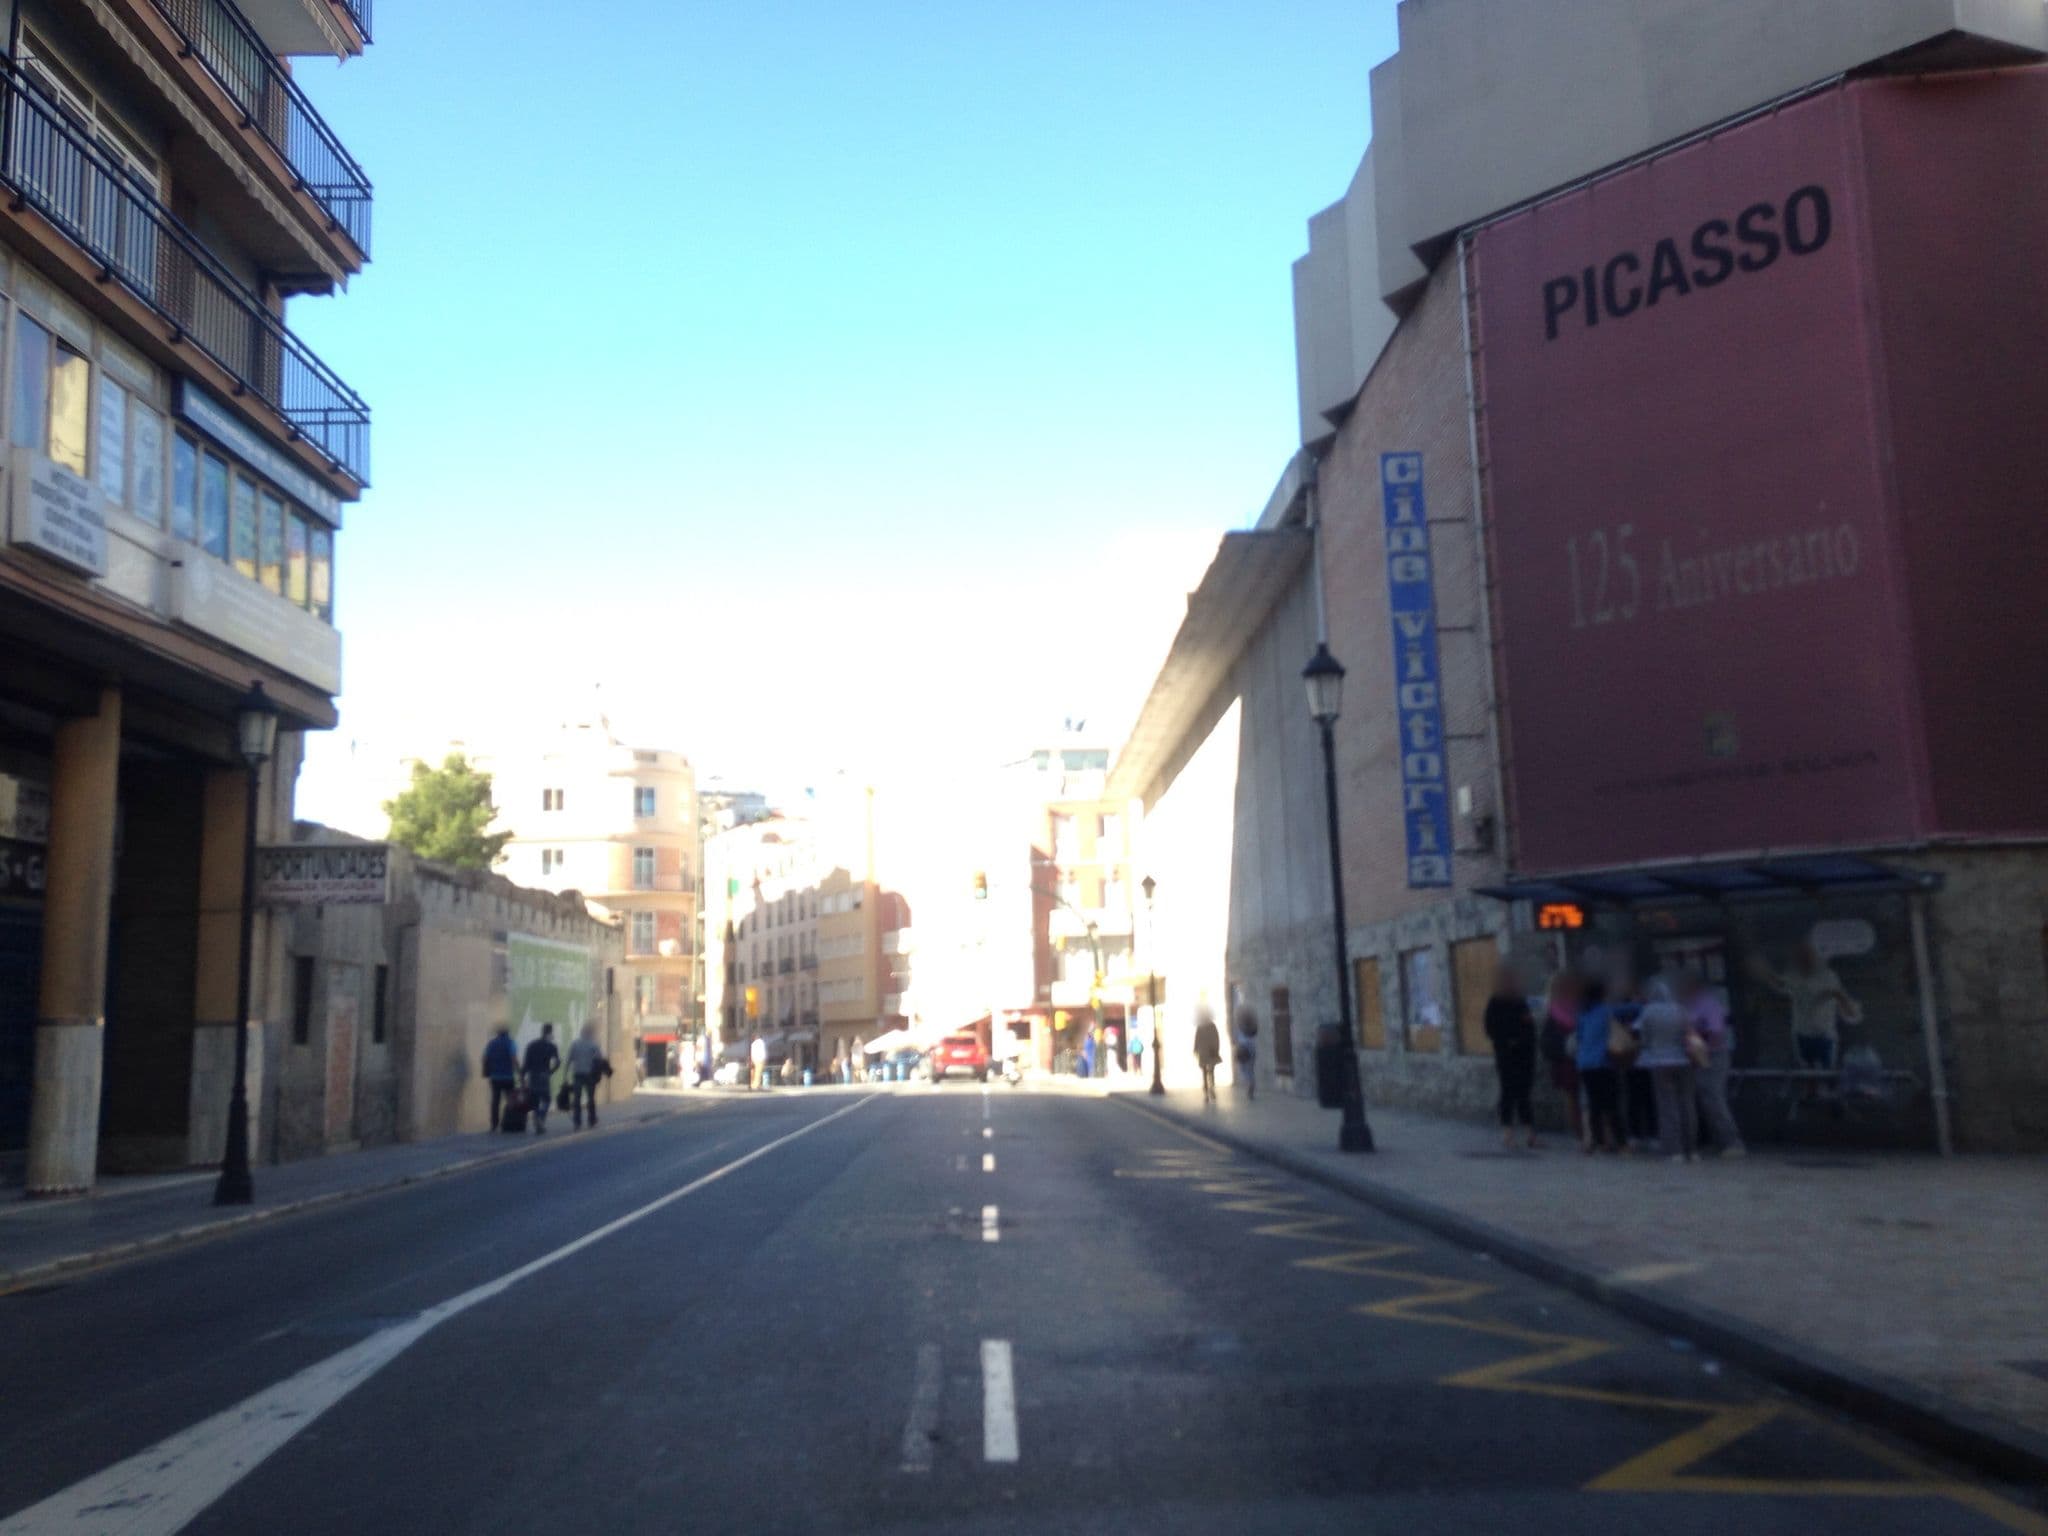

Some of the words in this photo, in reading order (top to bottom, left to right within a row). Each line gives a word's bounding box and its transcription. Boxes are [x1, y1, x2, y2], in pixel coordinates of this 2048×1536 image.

[1542, 185, 1832, 341] PICASSO
[1567, 523, 1641, 629] 125
[1655, 503, 1859, 611] Aniversario
